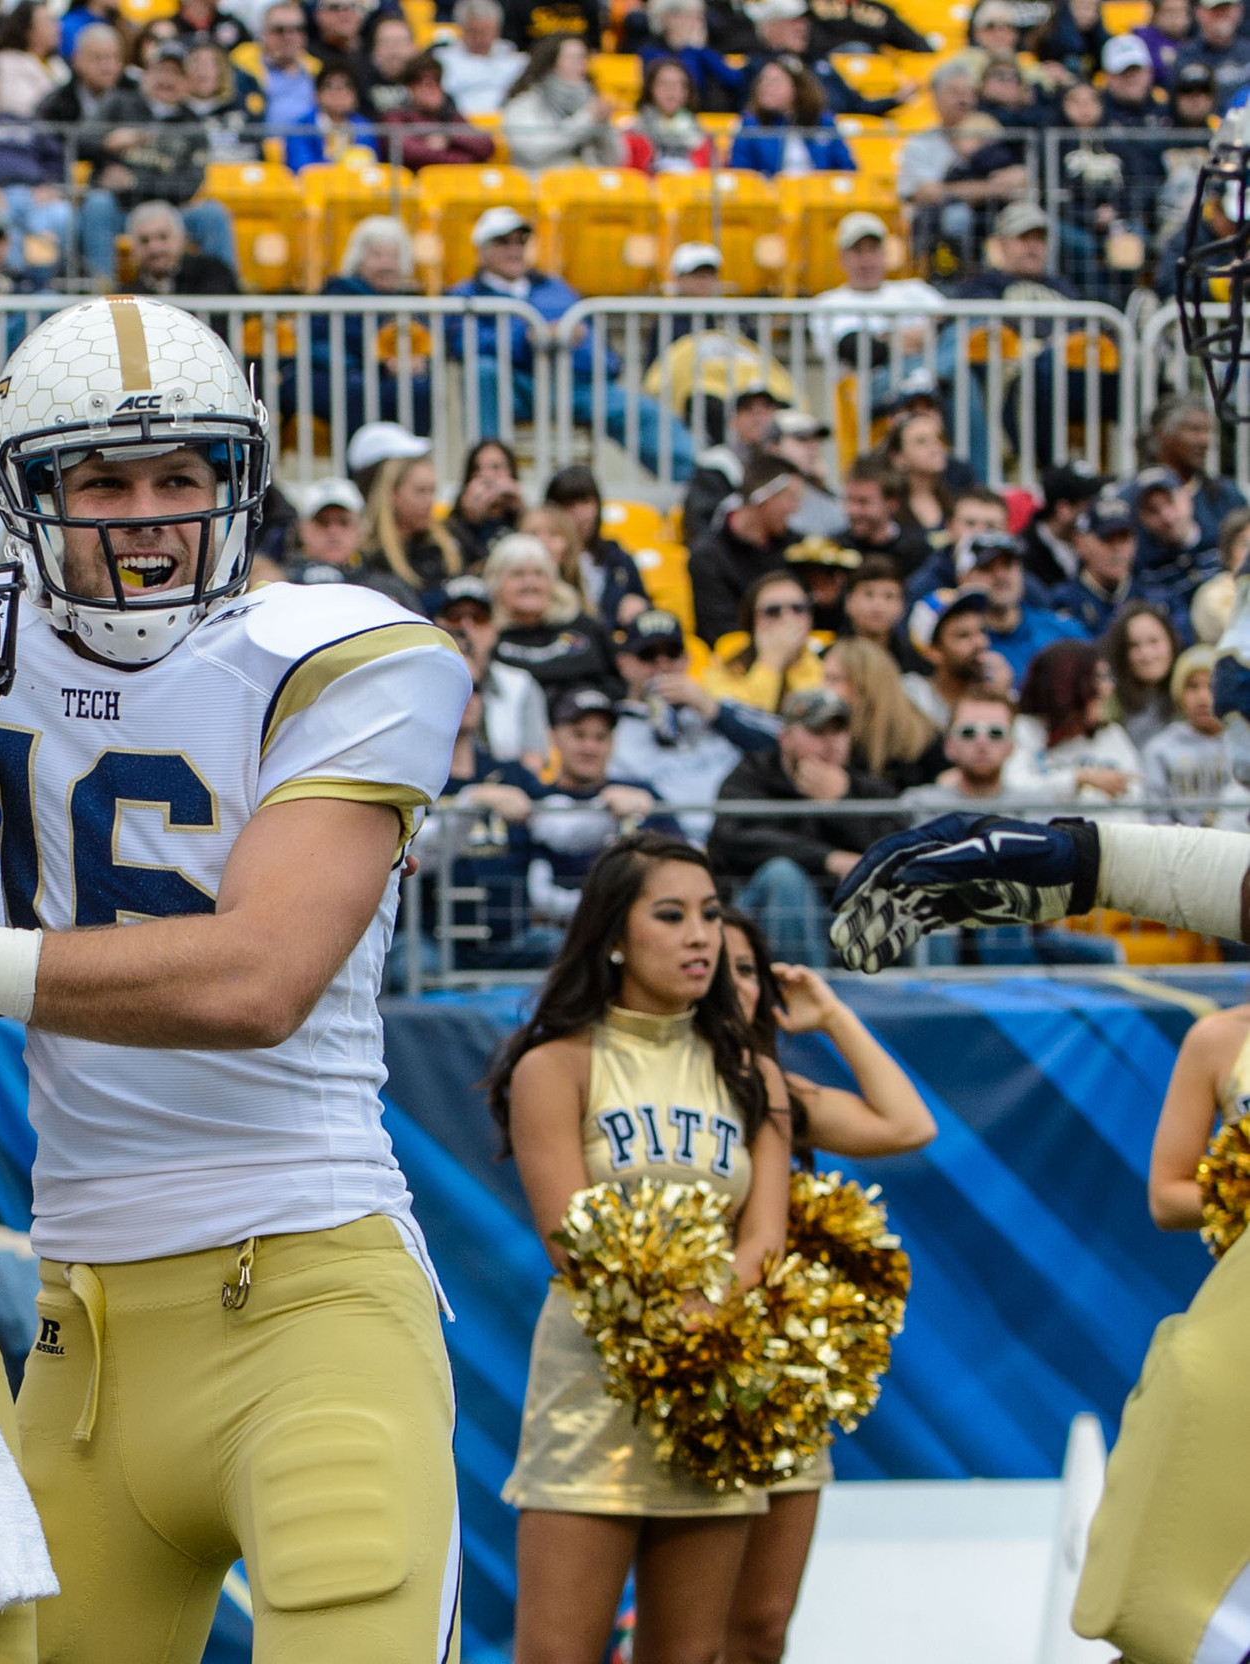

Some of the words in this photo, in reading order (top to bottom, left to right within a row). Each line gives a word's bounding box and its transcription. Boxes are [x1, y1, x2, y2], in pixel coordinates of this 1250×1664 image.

[115, 394, 163, 411] ACC
[61, 687, 120, 720] TECH
[598, 1103, 741, 1179] PITT
[40, 1317, 61, 1345] R
